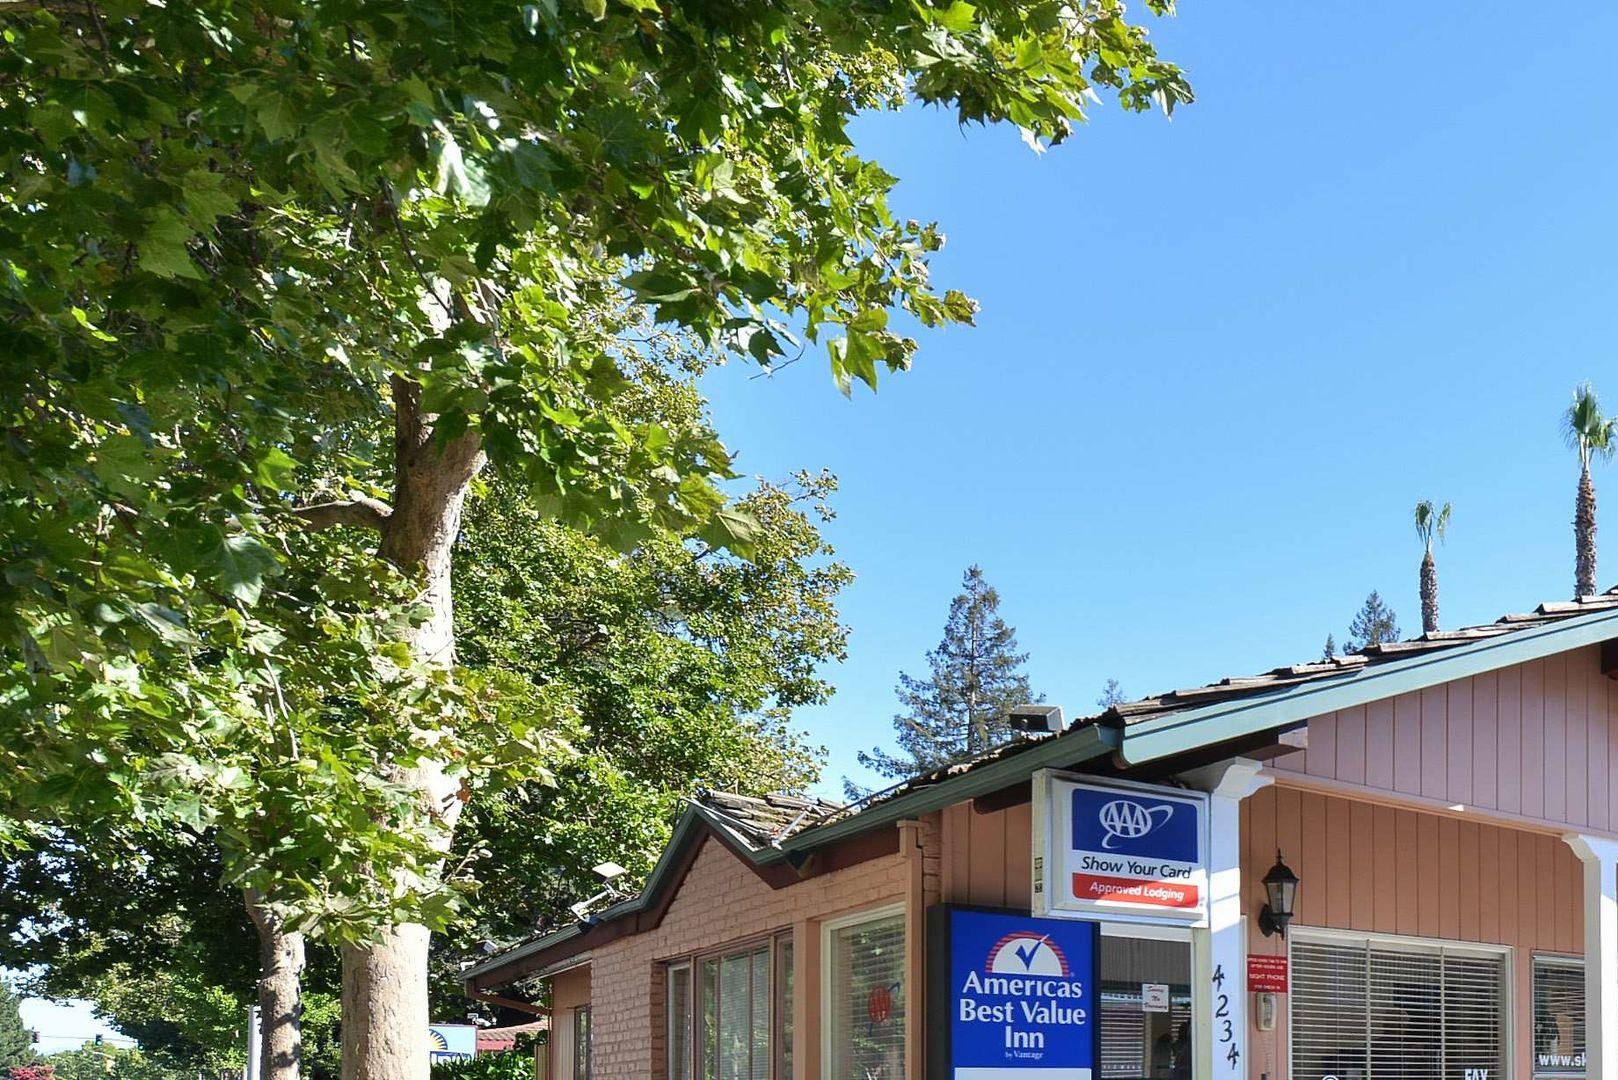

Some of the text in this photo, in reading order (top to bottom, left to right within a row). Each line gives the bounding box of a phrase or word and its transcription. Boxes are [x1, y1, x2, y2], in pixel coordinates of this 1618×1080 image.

[1104, 801, 1148, 838] AAA
[1081, 856, 1192, 879] Show Your Card
[1090, 881, 1185, 902] Approved Lodging
[962, 970, 1083, 998] Americas
[960, 998, 1086, 1025] Best Value
[1212, 964, 1240, 1071] 4234
[1005, 1025, 1045, 1049] Inn
